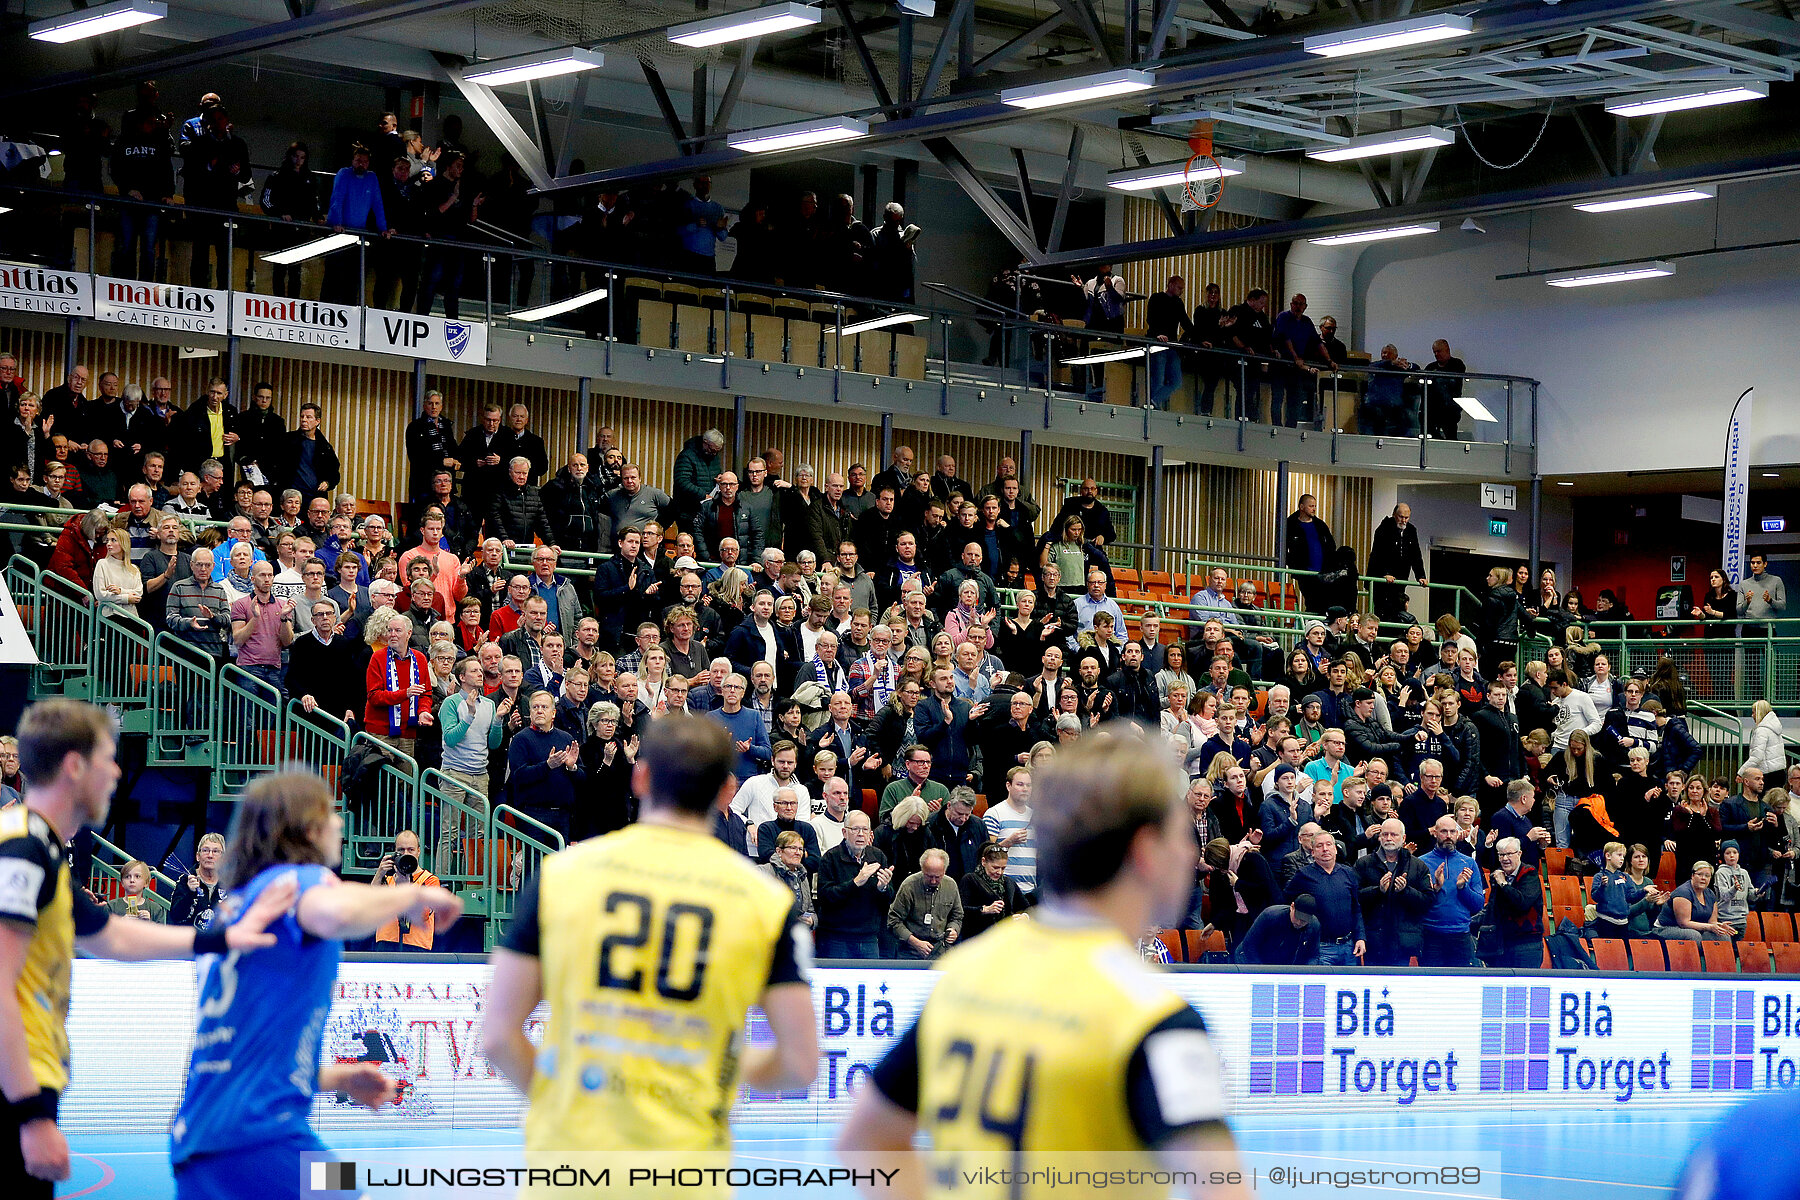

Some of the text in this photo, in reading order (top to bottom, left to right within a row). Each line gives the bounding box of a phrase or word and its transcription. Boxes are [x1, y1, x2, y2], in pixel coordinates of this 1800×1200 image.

[125, 146, 156, 156] GANT
[0, 267, 79, 295] attias
[108, 281, 215, 314] mattias
[116, 309, 207, 332] CATERING
[245, 298, 348, 329] mattias
[253, 324, 340, 346] CATERING
[383, 316, 430, 348] VIP
[1503, 488, 1514, 506] H
[597, 890, 715, 1002] 20
[824, 982, 894, 1036] Blå
[1336, 987, 1395, 1036] Blå
[1560, 990, 1612, 1036] Blå
[1332, 1048, 1458, 1105] Torget
[1556, 1047, 1671, 1103] Torget
[936, 1038, 1039, 1165] 24
